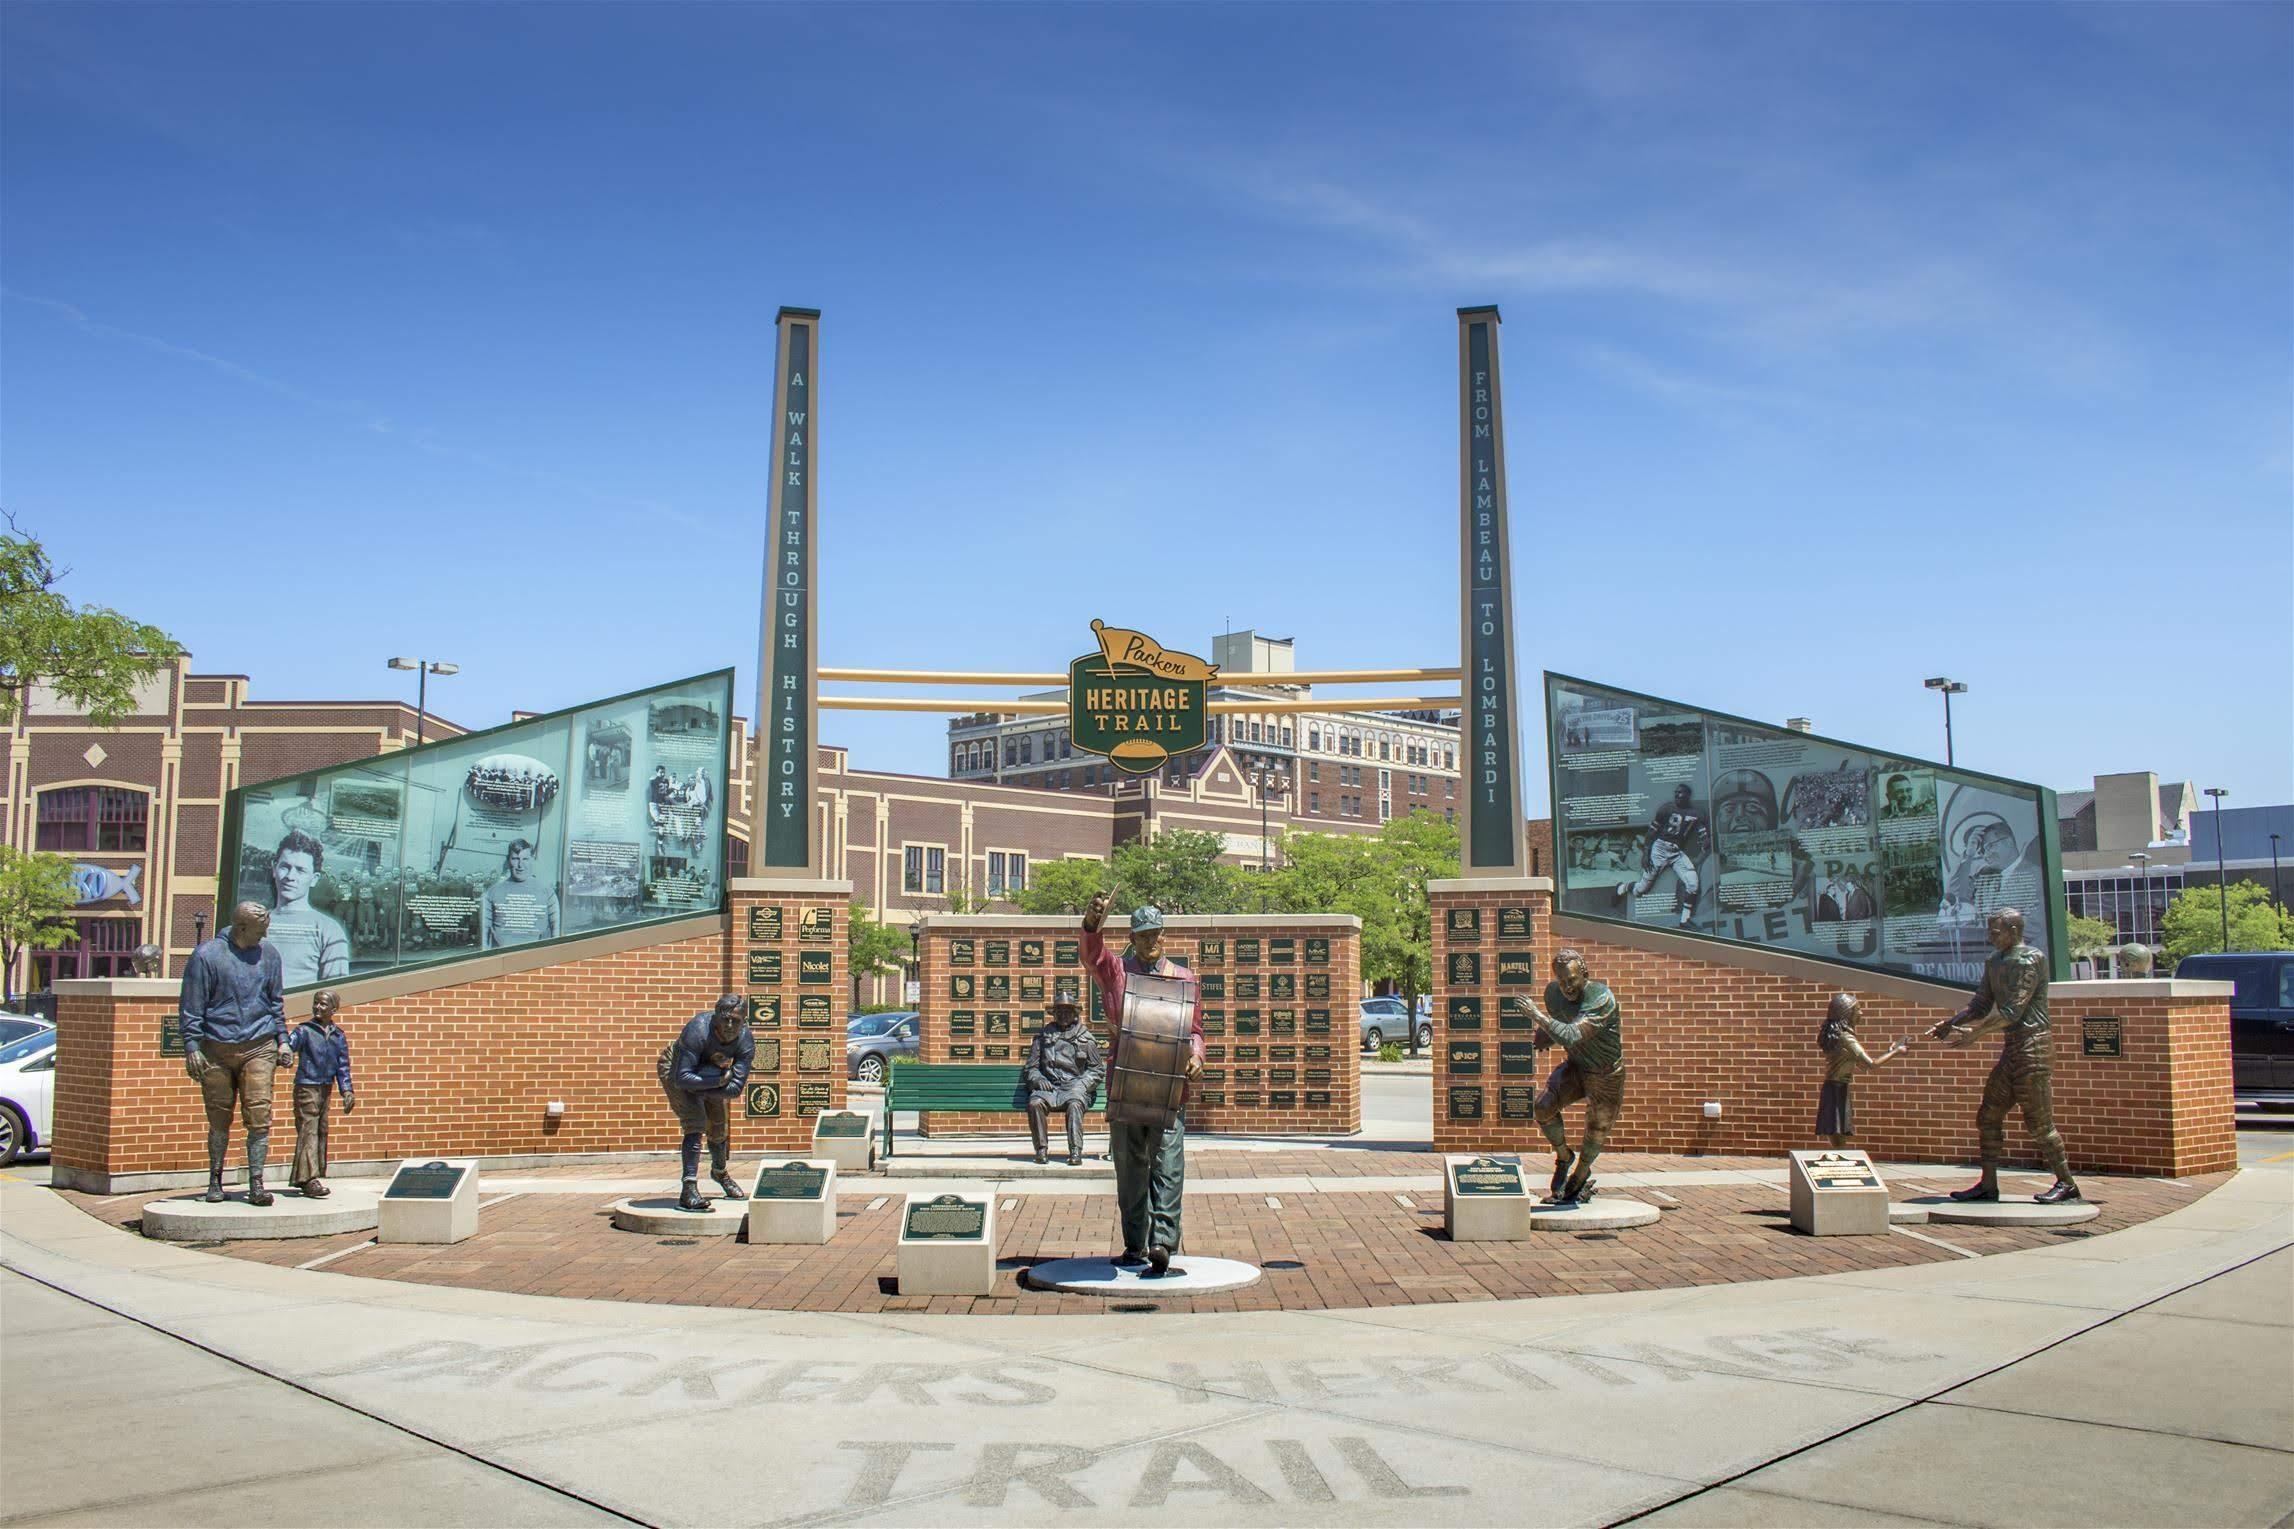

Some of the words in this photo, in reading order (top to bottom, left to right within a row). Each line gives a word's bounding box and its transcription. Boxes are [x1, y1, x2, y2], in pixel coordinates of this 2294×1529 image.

[792, 373, 803, 386] A
[1475, 372, 1489, 437] FROM
[788, 412, 805, 485] WALK
[1477, 460, 1492, 580] LAMBEAU
[784, 511, 800, 648] THROUGH
[1482, 604, 1494, 635] TO
[1123, 636, 1185, 675] Packers
[1086, 689, 1190, 710] HERITAGE
[1095, 715, 1182, 731] TRAIL
[781, 676, 797, 817] HISTORY
[1482, 659, 1496, 802] LOMBARDI
[802, 924, 831, 934] Performa
[802, 961, 829, 970] Nicolet
[1915, 962, 1985, 985] BEAUMON
[320, 1338, 1059, 1407] PACKERS
[836, 1438, 1468, 1508] TRAIL
